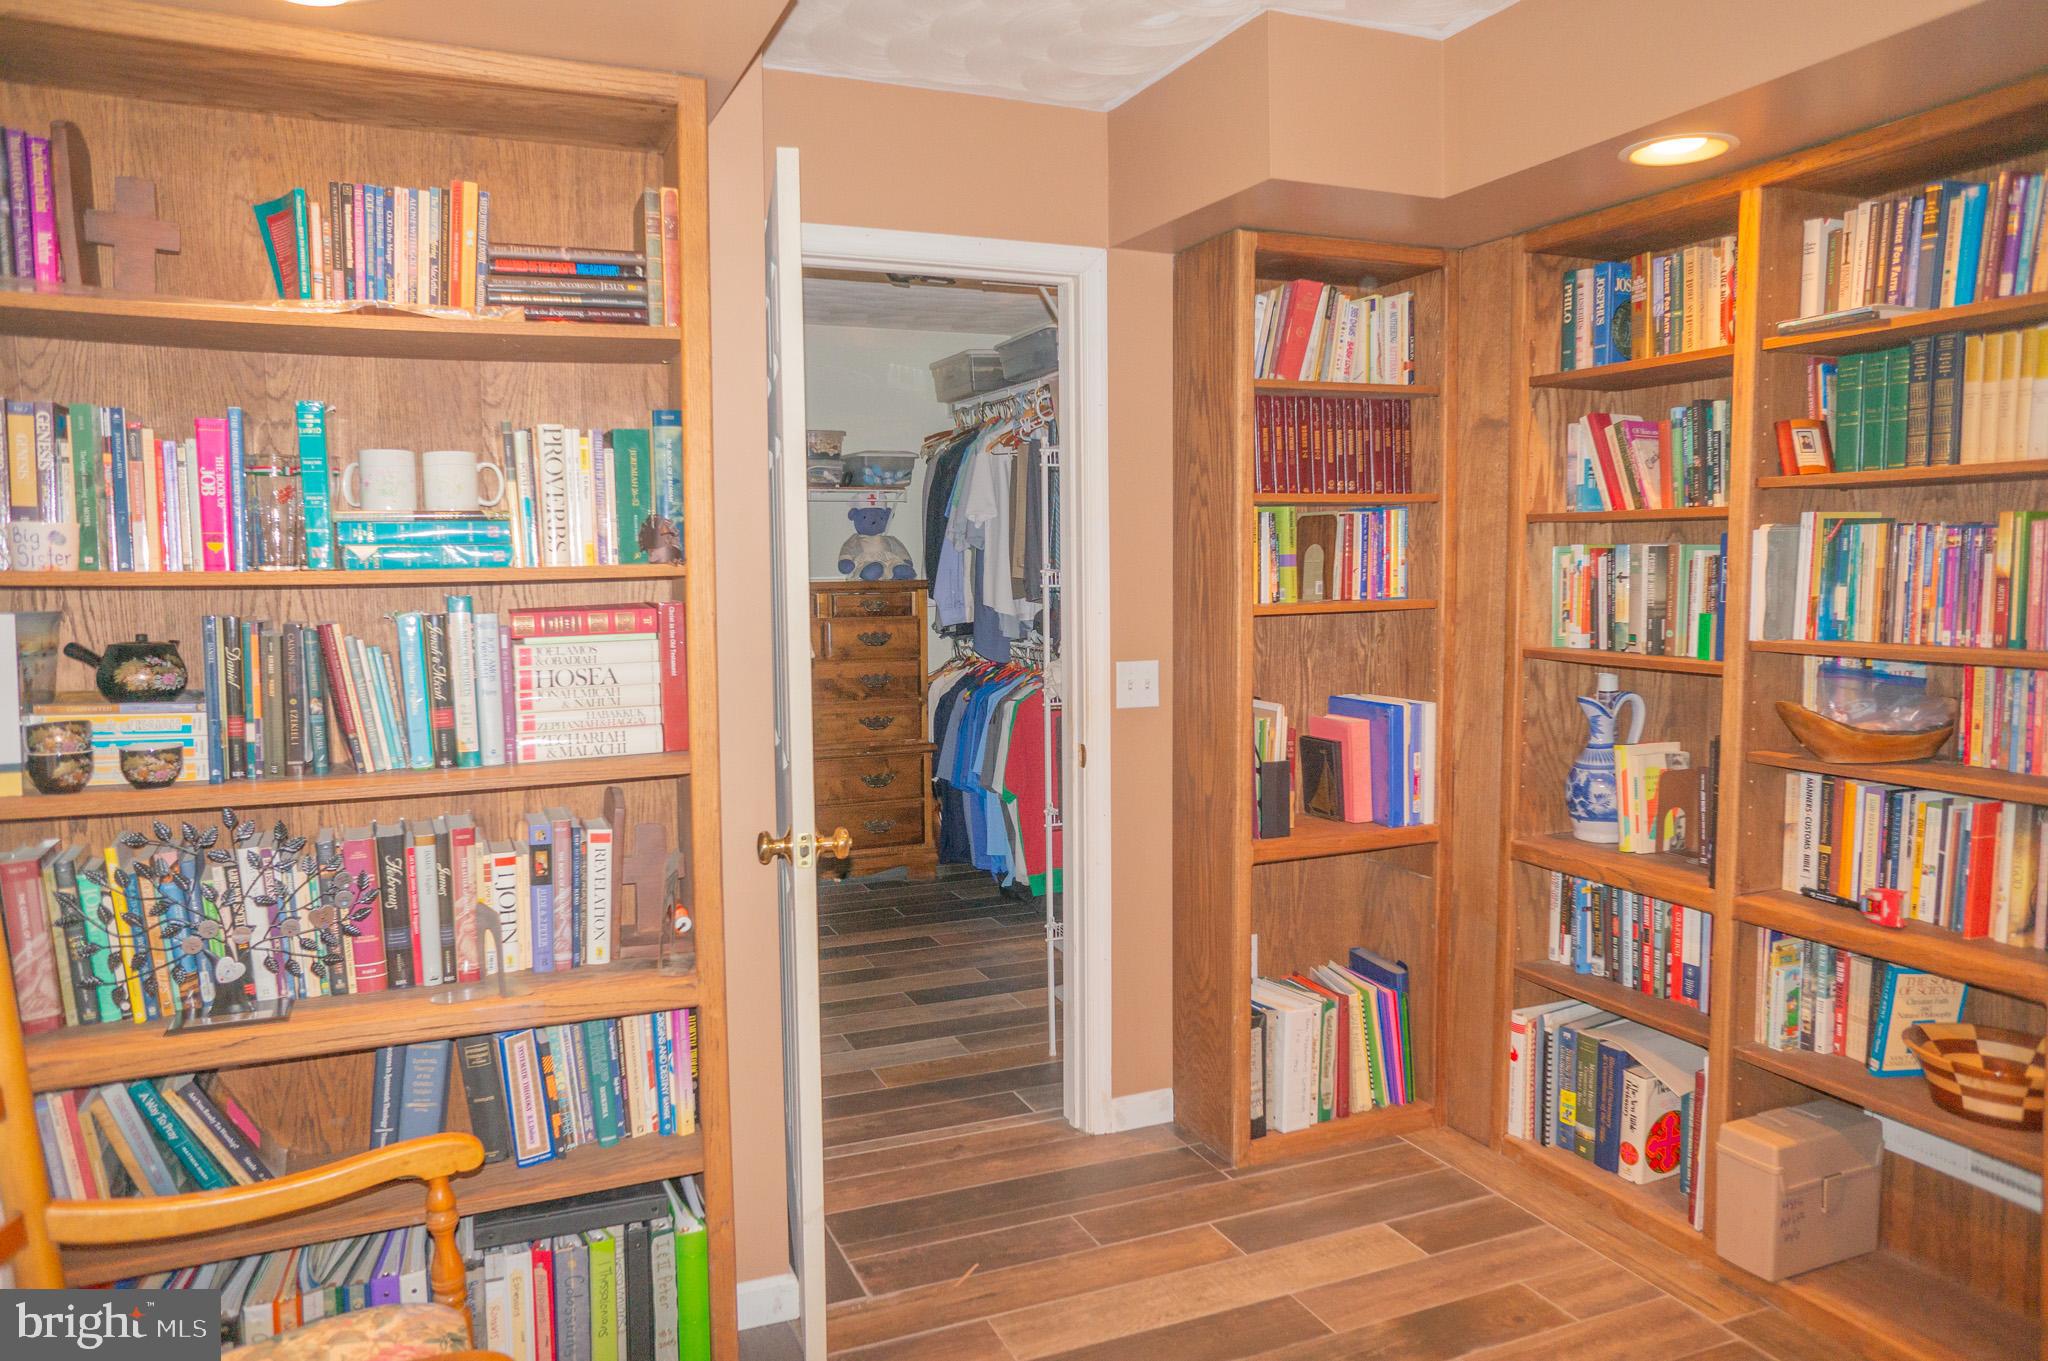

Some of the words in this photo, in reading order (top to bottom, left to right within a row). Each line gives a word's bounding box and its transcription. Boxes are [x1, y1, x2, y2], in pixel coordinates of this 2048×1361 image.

[1891, 245, 1904, 264] FOR
[1563, 283, 1573, 324] PHILO
[1596, 277, 1606, 326] JOSEPHUS
[15, 433, 29, 480] GENESIS
[35, 411, 51, 471] GENESIS
[215, 456, 224, 472] THE
[628, 448, 639, 489] JEREMIAH
[200, 466, 215, 497] JOB
[216, 473, 224, 497] BOOK
[542, 428, 567, 553] PROVERBS
[12, 525, 41, 552] Big
[207, 642, 215, 664] DANIEL
[427, 622, 443, 656] Jonah
[224, 646, 242, 690] Daniel
[546, 654, 599, 667] OBADIAH
[432, 663, 447, 701] Micah
[535, 666, 620, 690] HOSEA
[574, 696, 621, 710] NAHUM
[289, 709, 297, 740] EZEKIEL
[313, 725, 323, 751] RIVERS
[537, 730, 627, 747] ZECHARIAH
[559, 742, 628, 759] MALACHI
[1805, 777, 1815, 813] MANNERS
[1803, 816, 1813, 851] CUSTOMS
[436, 862, 451, 896] James
[1803, 853, 1812, 874] BIBLE
[385, 855, 403, 910] Hebrews
[592, 847, 607, 942] REVELATION
[495, 882, 519, 944] JOHN
[1674, 937, 1682, 957] RICH
[659, 1044, 667, 1064] AND
[522, 1081, 533, 1112] THEOLOGY
[660, 1065, 670, 1097] DESTINY
[144, 1098, 162, 1116] Way
[156, 1113, 170, 1125] To
[162, 1123, 179, 1141] Pray
[657, 1275, 674, 1310] Peter
[563, 1274, 586, 1359] Colossians
